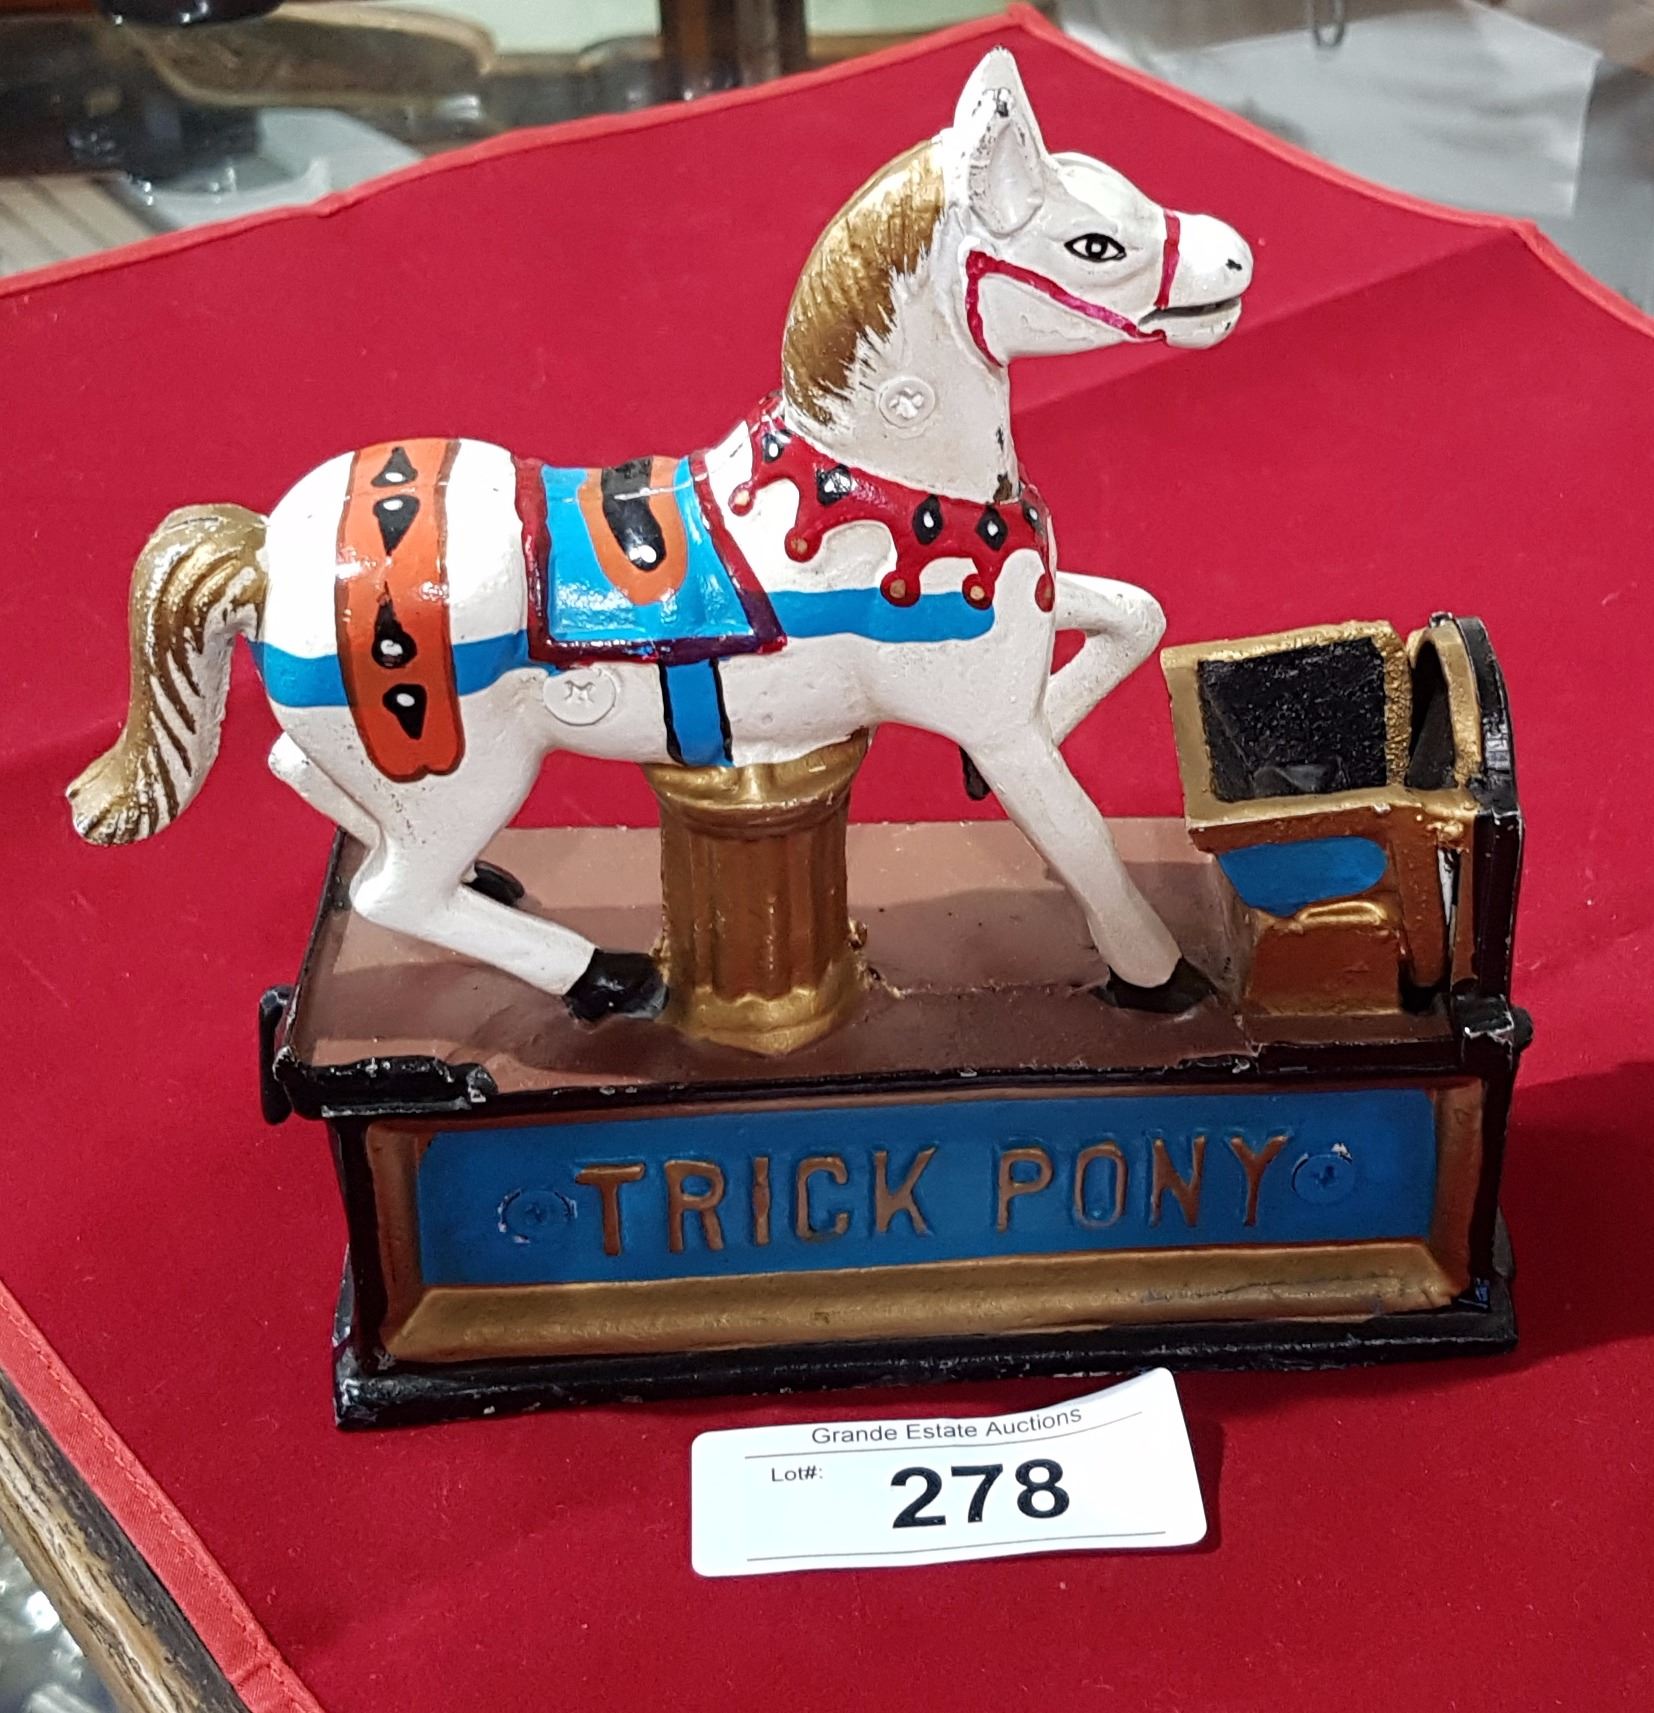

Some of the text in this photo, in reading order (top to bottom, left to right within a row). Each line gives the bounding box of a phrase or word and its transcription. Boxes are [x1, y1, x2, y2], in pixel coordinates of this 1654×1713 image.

[574, 1134, 1291, 1257] TRICK PONY
[811, 1407, 1083, 1445] Grande Estate Auctions
[770, 1458, 1071, 1530] Lot#: 278
